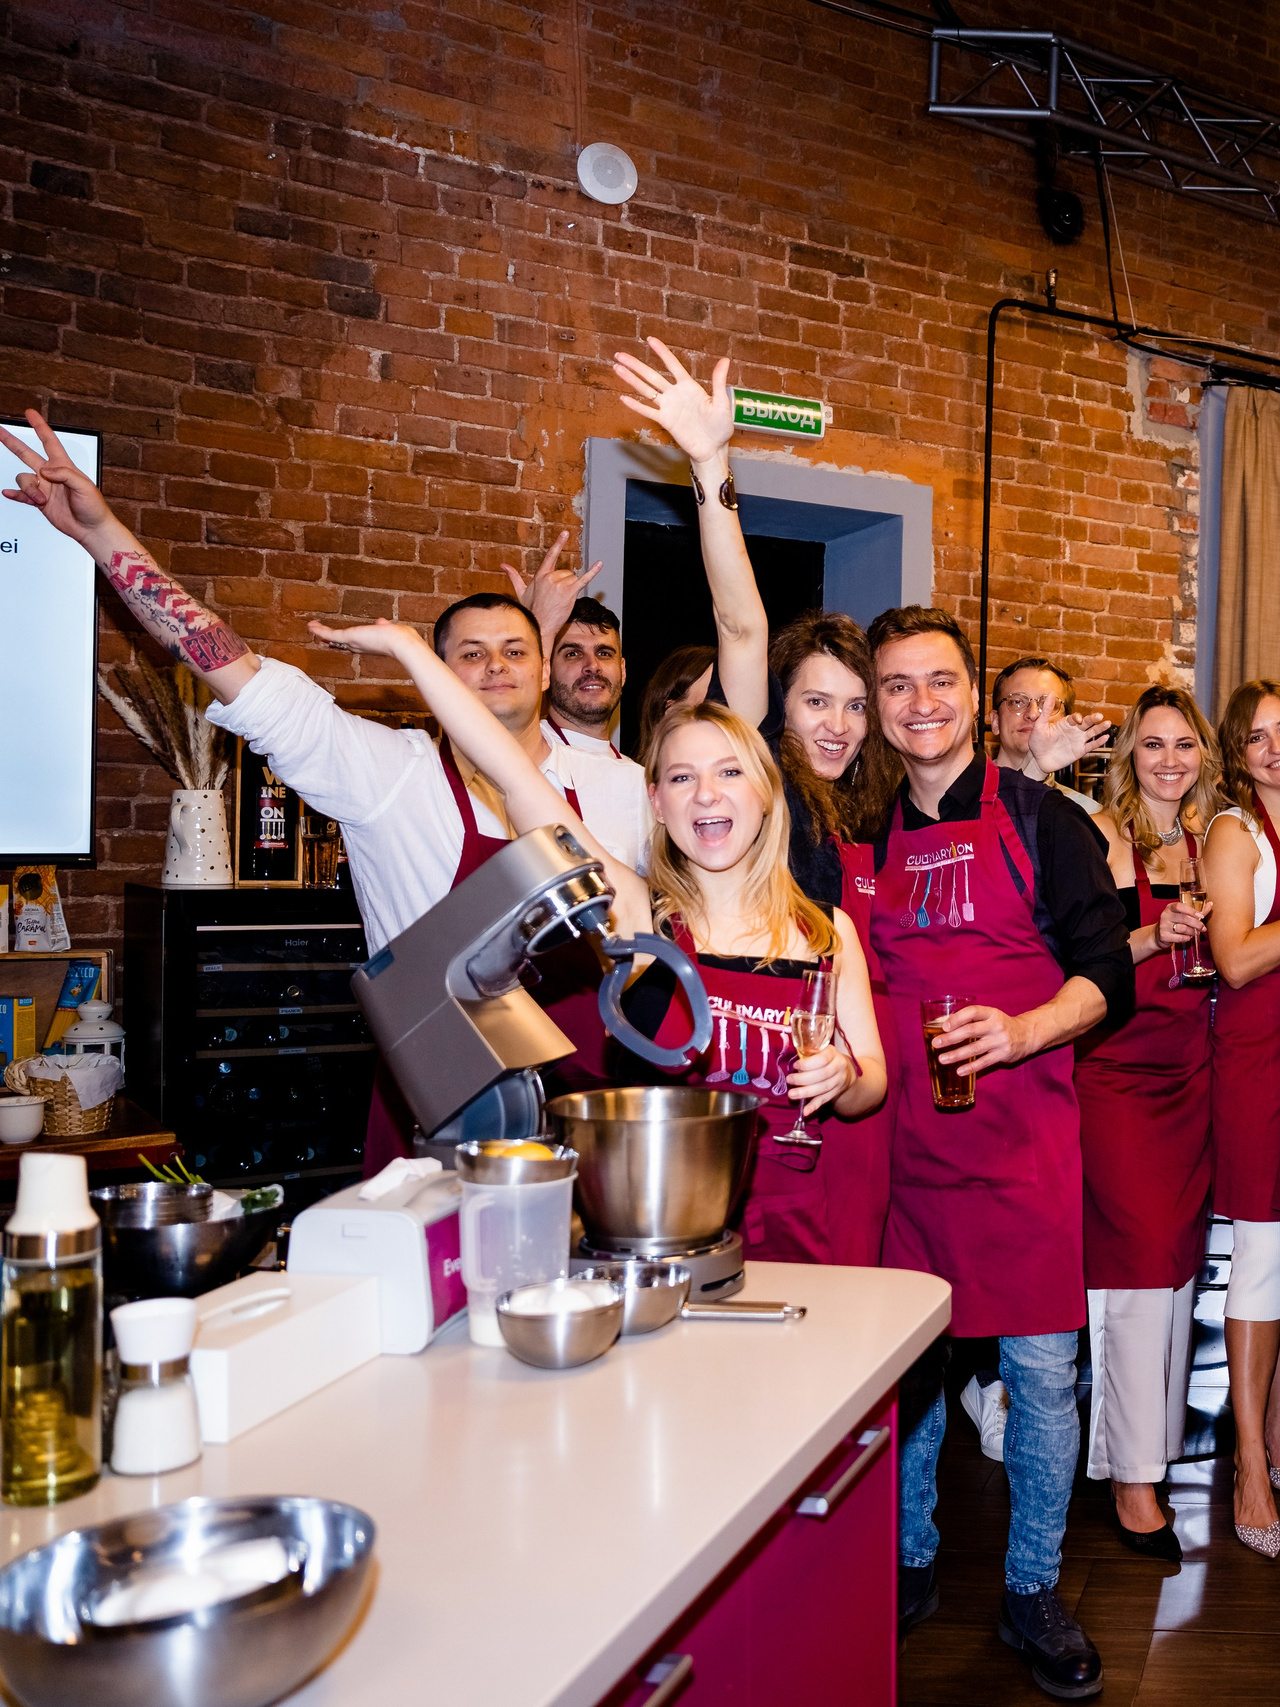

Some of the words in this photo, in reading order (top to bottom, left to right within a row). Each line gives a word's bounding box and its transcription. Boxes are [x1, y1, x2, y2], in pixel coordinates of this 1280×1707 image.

[742, 397, 816, 430] ВЫХОД
[261, 787, 286, 798] INE
[261, 807, 284, 818] ON
